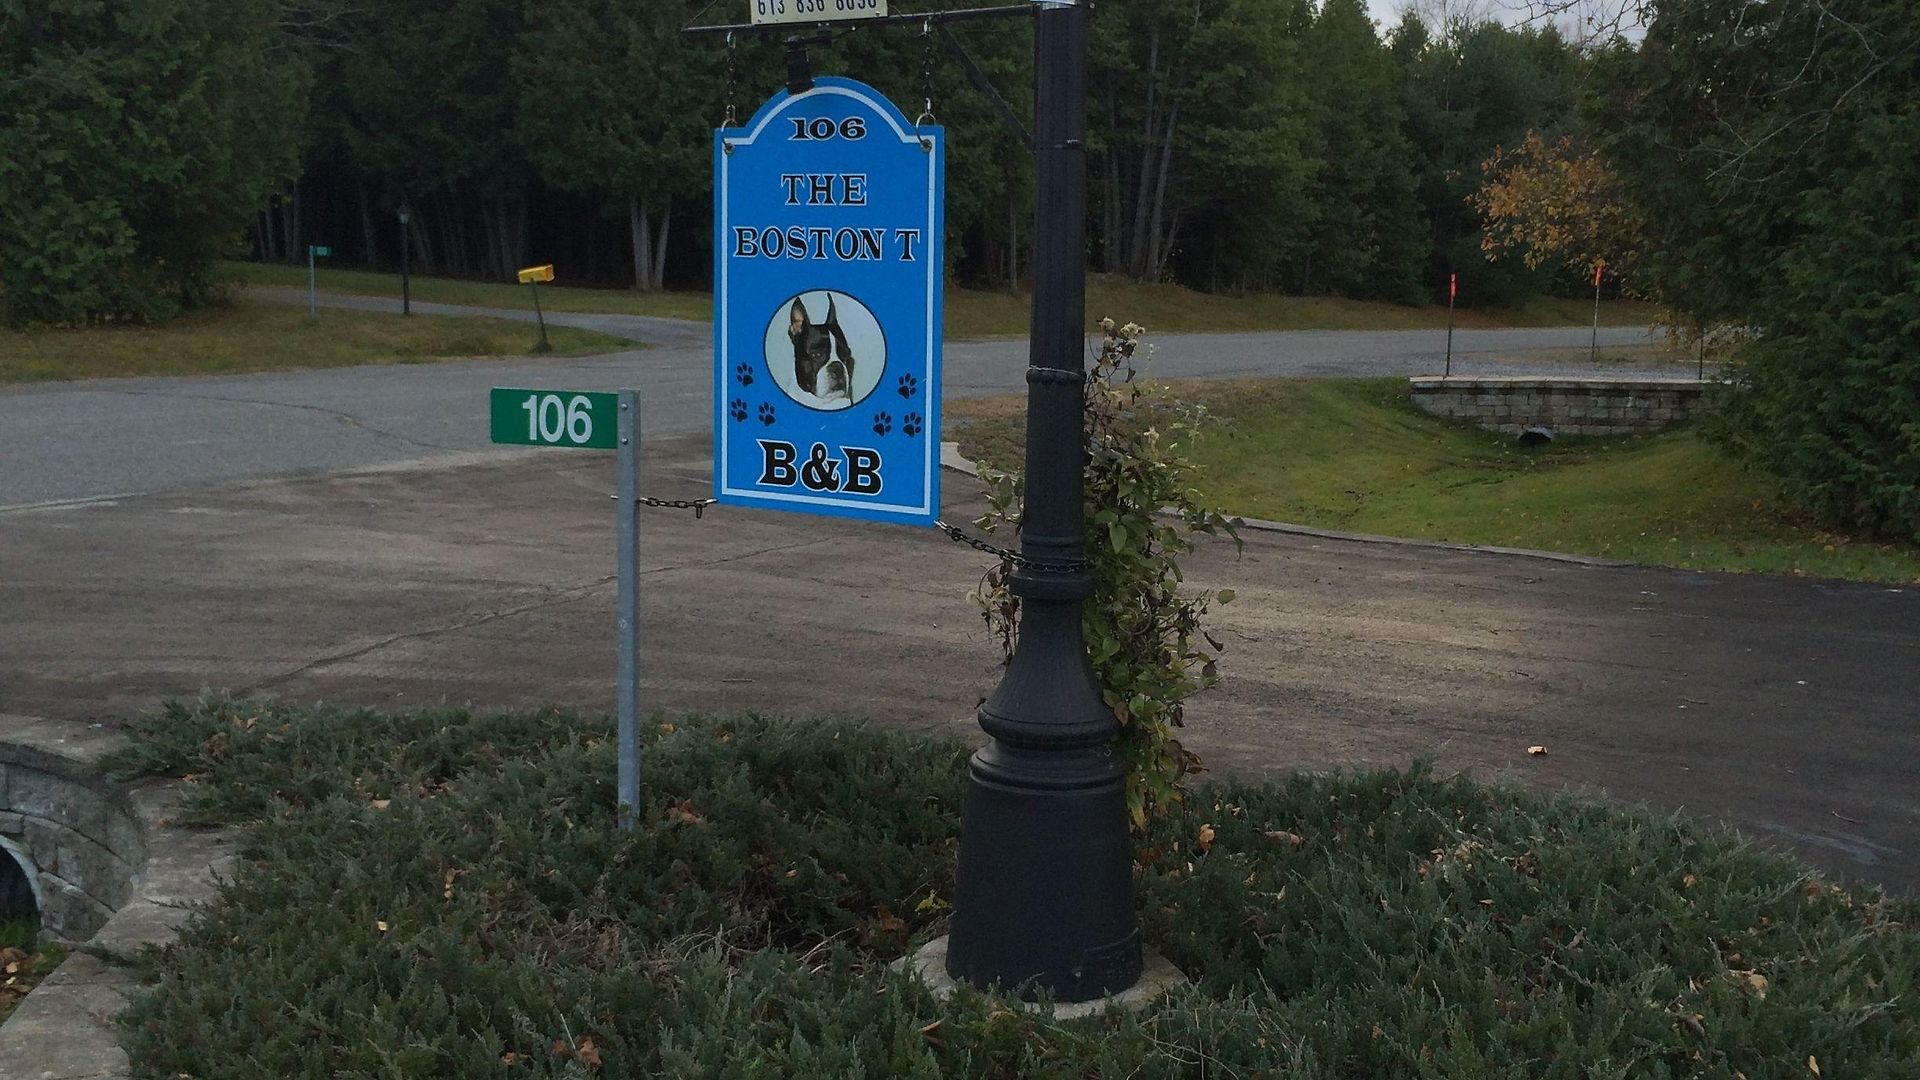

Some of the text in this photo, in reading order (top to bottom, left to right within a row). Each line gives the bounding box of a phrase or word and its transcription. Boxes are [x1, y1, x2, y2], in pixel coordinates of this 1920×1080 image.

[787, 117, 867, 141] 106
[781, 173, 867, 206] THE
[732, 226, 920, 262] BOSTON T
[522, 394, 593, 444] 106
[756, 438, 883, 496] B&B
